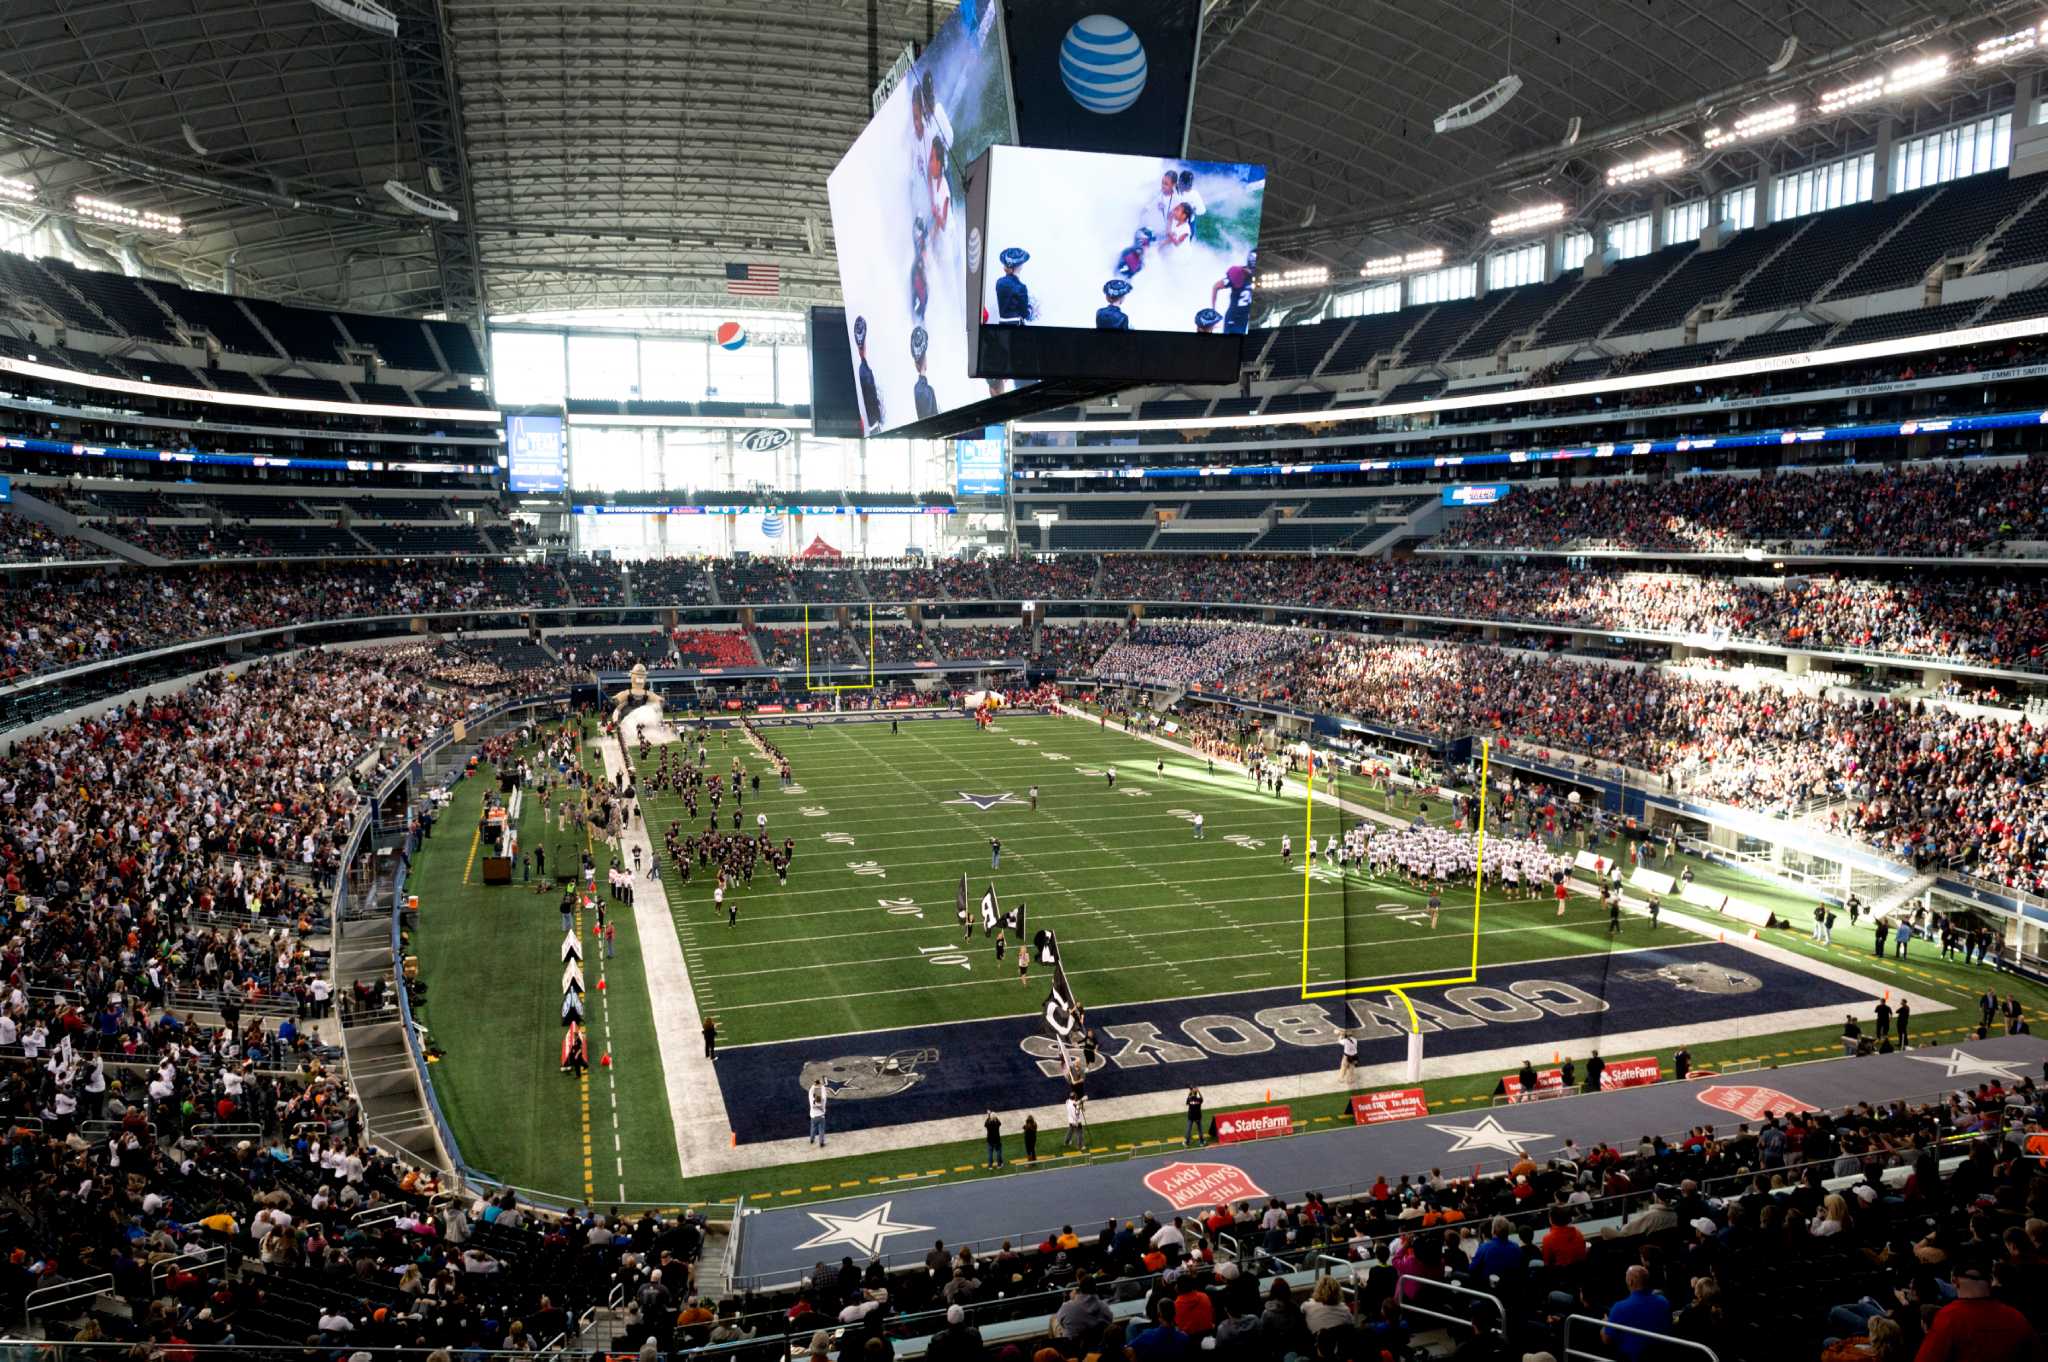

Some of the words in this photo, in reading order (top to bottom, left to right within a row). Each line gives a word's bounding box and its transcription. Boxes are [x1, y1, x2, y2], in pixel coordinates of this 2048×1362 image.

[1991, 367, 2020, 379] EMMITT
[1020, 980, 1610, 1078] COWBOYS
[1612, 1066, 1658, 1082] StateFarm
[1235, 1115, 1289, 1133] StateFarm
[1163, 1164, 1202, 1191] ARMY
[1172, 1166, 1238, 1205] SALVATION
[1209, 1183, 1244, 1201] THE
